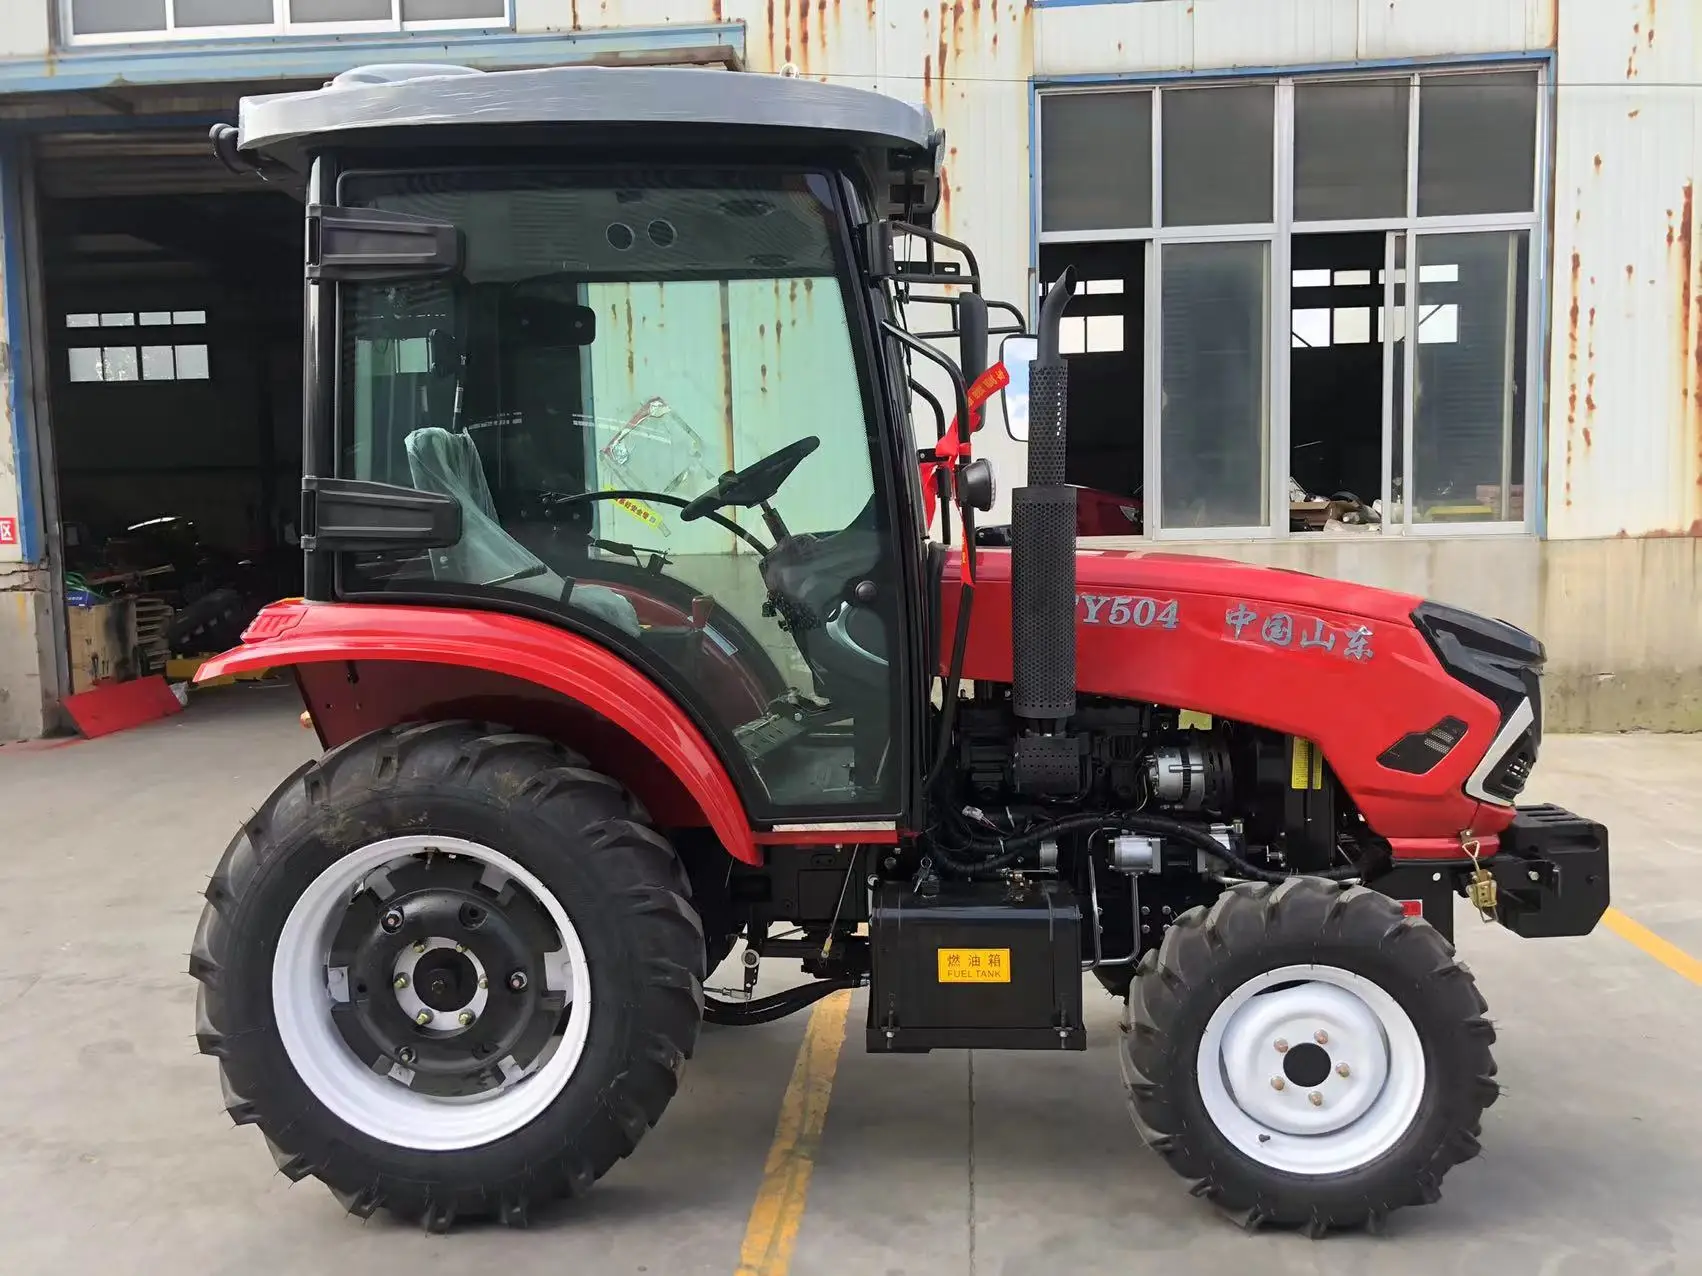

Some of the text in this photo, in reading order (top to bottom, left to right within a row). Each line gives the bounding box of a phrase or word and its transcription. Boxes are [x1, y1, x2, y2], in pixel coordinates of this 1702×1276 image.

[1075, 594, 1180, 629] Y504
[1225, 603, 1374, 661] 中国山东
[947, 953, 1001, 967] 燃油箱
[947, 970, 1001, 978] FUEL TANK
